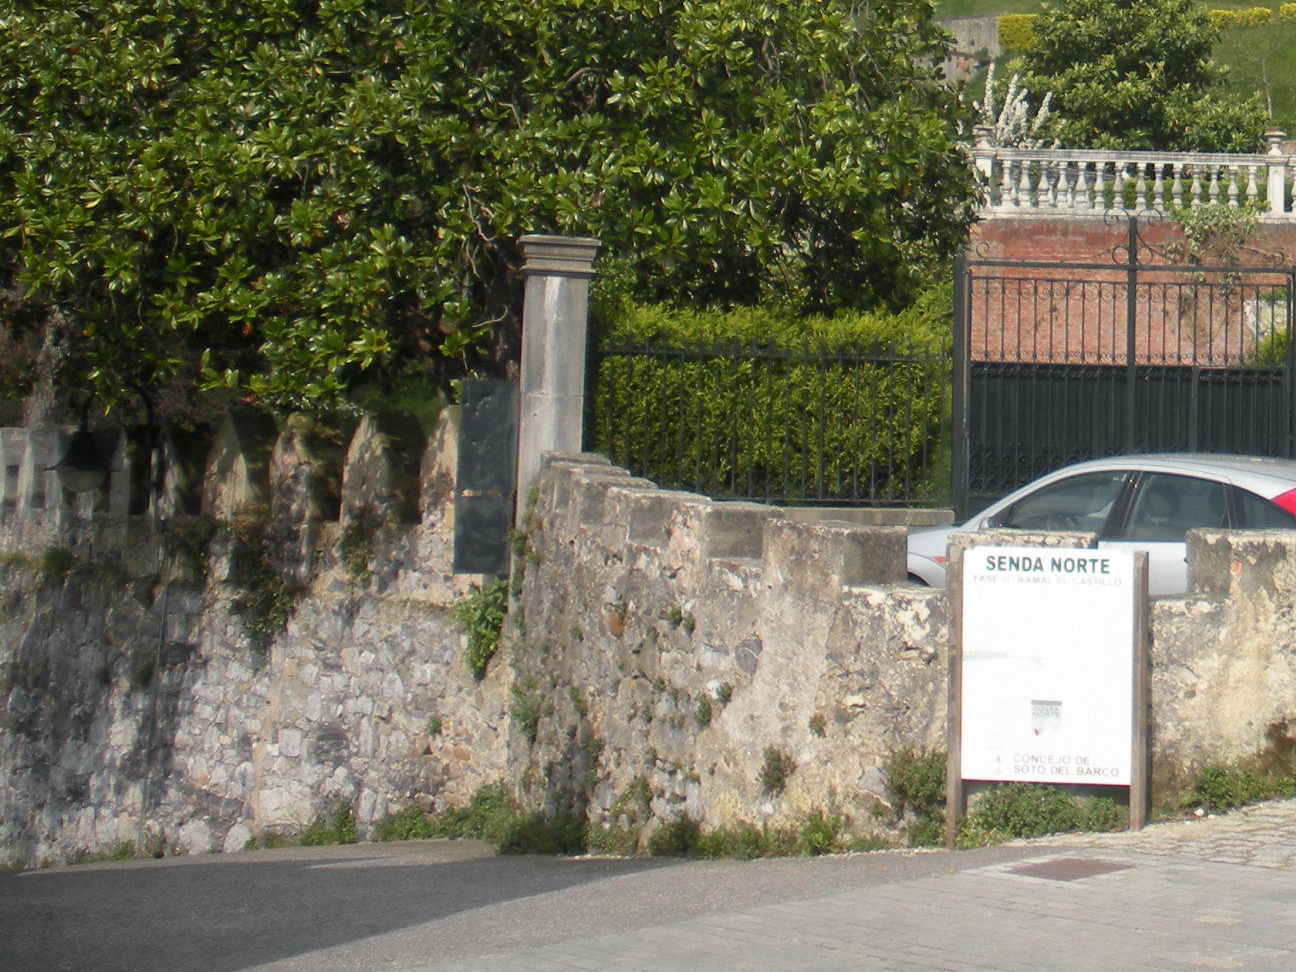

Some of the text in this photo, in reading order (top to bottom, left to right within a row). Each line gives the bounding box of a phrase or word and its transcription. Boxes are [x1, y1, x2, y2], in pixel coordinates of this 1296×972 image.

[986, 555, 1111, 574] SENDA NORTE
[974, 575, 997, 584] FASE
[1018, 576, 1052, 585] RAMAL
[1057, 577, 1067, 585] EL
[1072, 577, 1122, 587] CASTILLO
[1013, 754, 1090, 766] CONCEJO DE
[1013, 765, 1120, 777] SOTO DEL BARCO
